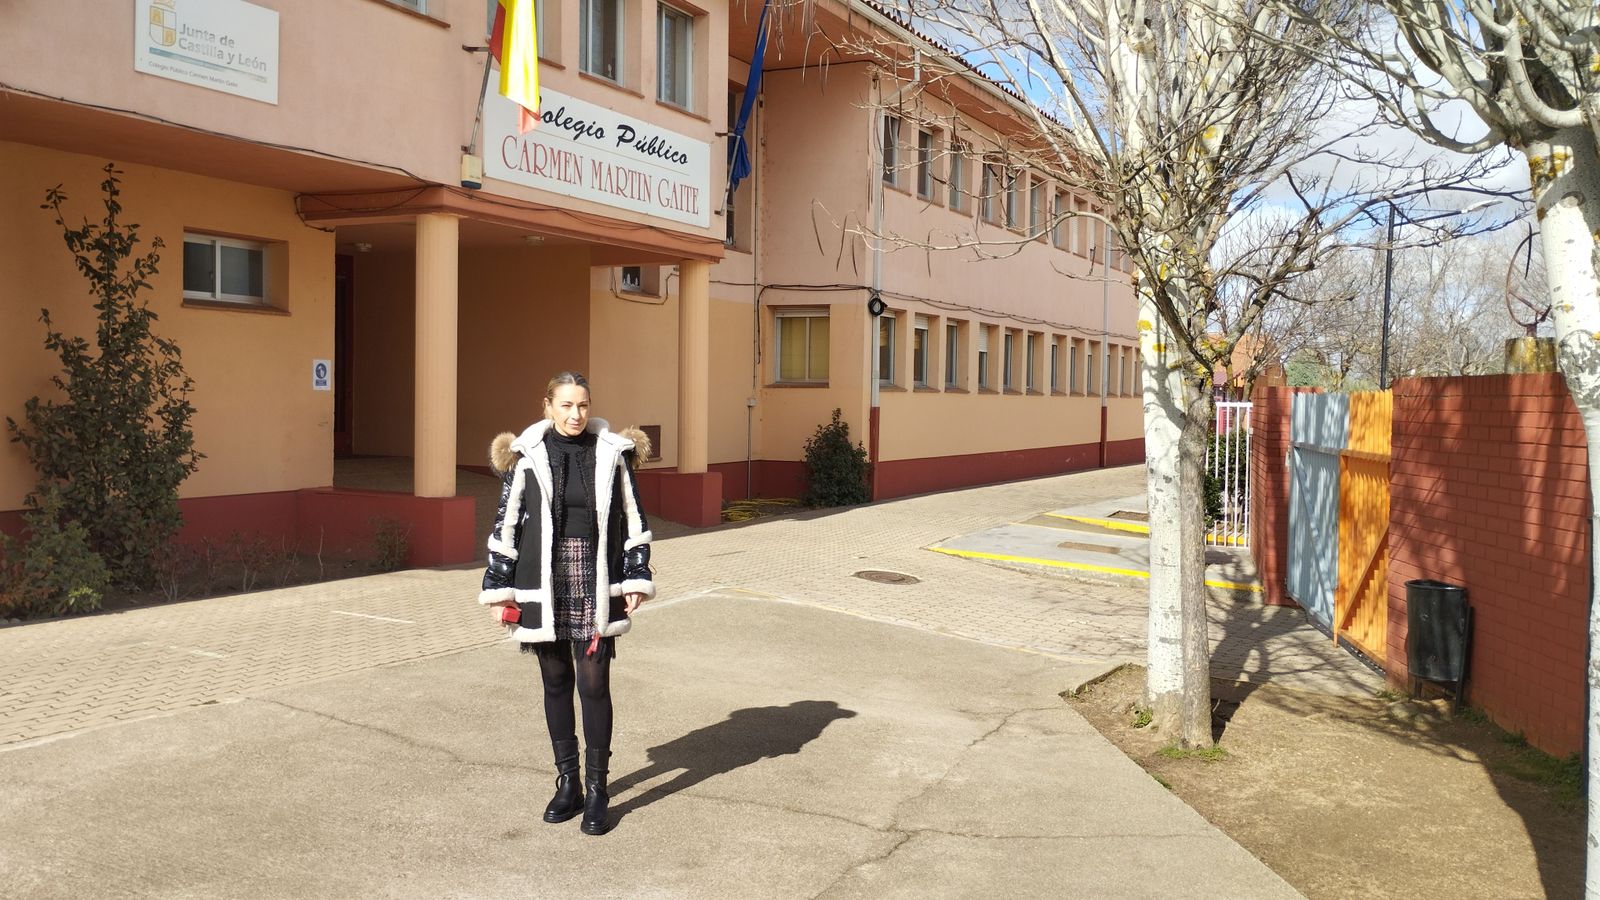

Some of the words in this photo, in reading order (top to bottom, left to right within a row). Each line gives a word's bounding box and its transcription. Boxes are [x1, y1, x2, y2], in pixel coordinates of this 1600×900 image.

[178, 37, 224, 60] Castilla
[226, 52, 235, 65] y
[238, 53, 267, 72] León
[179, 23, 216, 43] Junta
[219, 35, 235, 49] de
[538, 96, 605, 141] olegio
[616, 124, 688, 165] Público
[502, 135, 584, 187] CARMEN
[591, 158, 652, 204] MARTIN
[657, 178, 699, 215] GAITE
